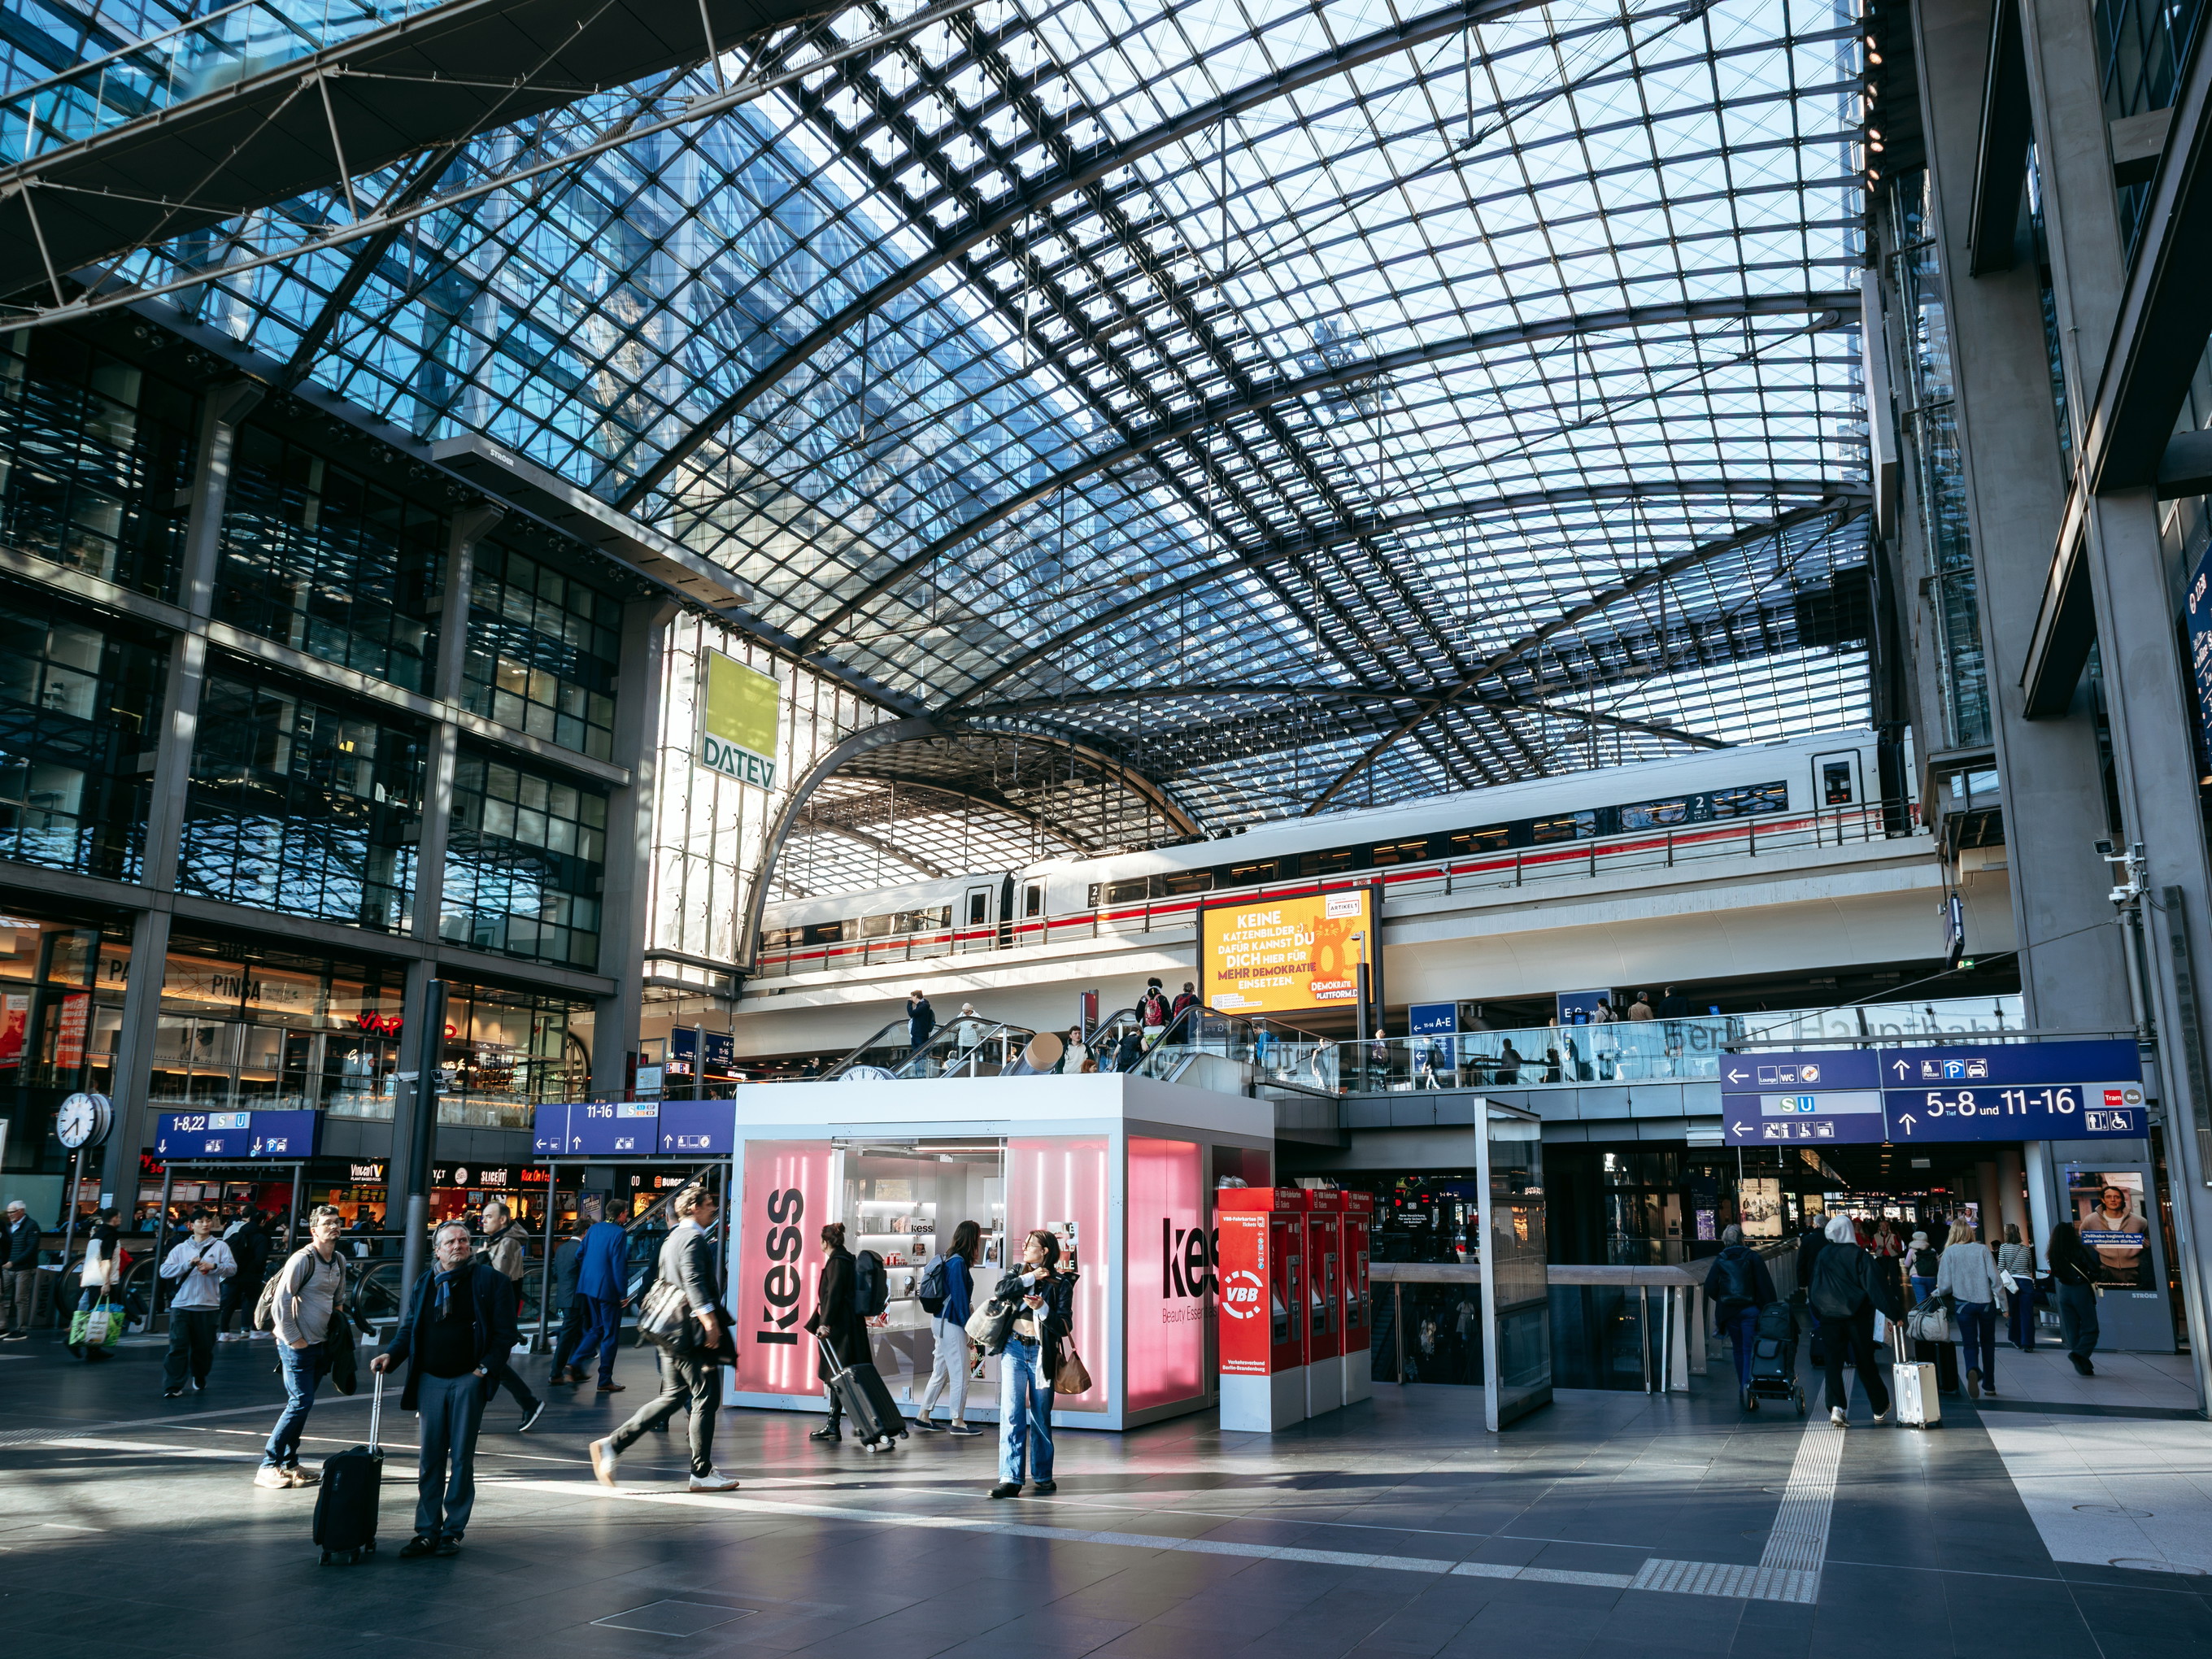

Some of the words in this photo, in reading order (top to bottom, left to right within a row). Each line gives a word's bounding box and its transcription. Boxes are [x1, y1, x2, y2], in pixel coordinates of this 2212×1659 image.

[703, 737, 775, 788] DATEV
[1696, 796, 1705, 808] 2
[1092, 886, 1098, 896] 2
[903, 913, 908, 923] 2
[1237, 911, 1281, 929] KEINE
[1223, 925, 1294, 942] KATZENBILDER
[1218, 941, 1249, 955] DAFÜR
[1252, 938, 1291, 951] KANNST
[1294, 932, 1315, 947] DU
[1226, 952, 1261, 968] DICH
[1262, 953, 1285, 964] HIER
[1287, 949, 1306, 961] FÜR
[1218, 968, 1250, 980] MEHR
[1252, 962, 1317, 978] DEMOKRATIE
[1238, 976, 1294, 990] EINSETZEN.
[1311, 981, 1351, 991] DEMOKRATIE
[1316, 989, 1357, 999] PLATTFORM.D
[1435, 1017, 1451, 1027] A-E
[1781, 1073, 1795, 1082] WC
[1781, 1097, 1795, 1112] S
[1800, 1097, 1812, 1112] U
[1927, 1091, 1976, 1117] 5-8
[1979, 1105, 2000, 1116] und
[2001, 1088, 2075, 1115] 11-16
[586, 1104, 612, 1118] 11-16
[173, 1115, 205, 1133] 1-8,22
[237, 1114, 245, 1126] U
[662, 1178, 686, 1187] BURGE
[911, 1224, 934, 1233] kess
[757, 1188, 804, 1345] kess
[1226, 1287, 1258, 1302] VBB
[1163, 1305, 1185, 1324] Beauty
